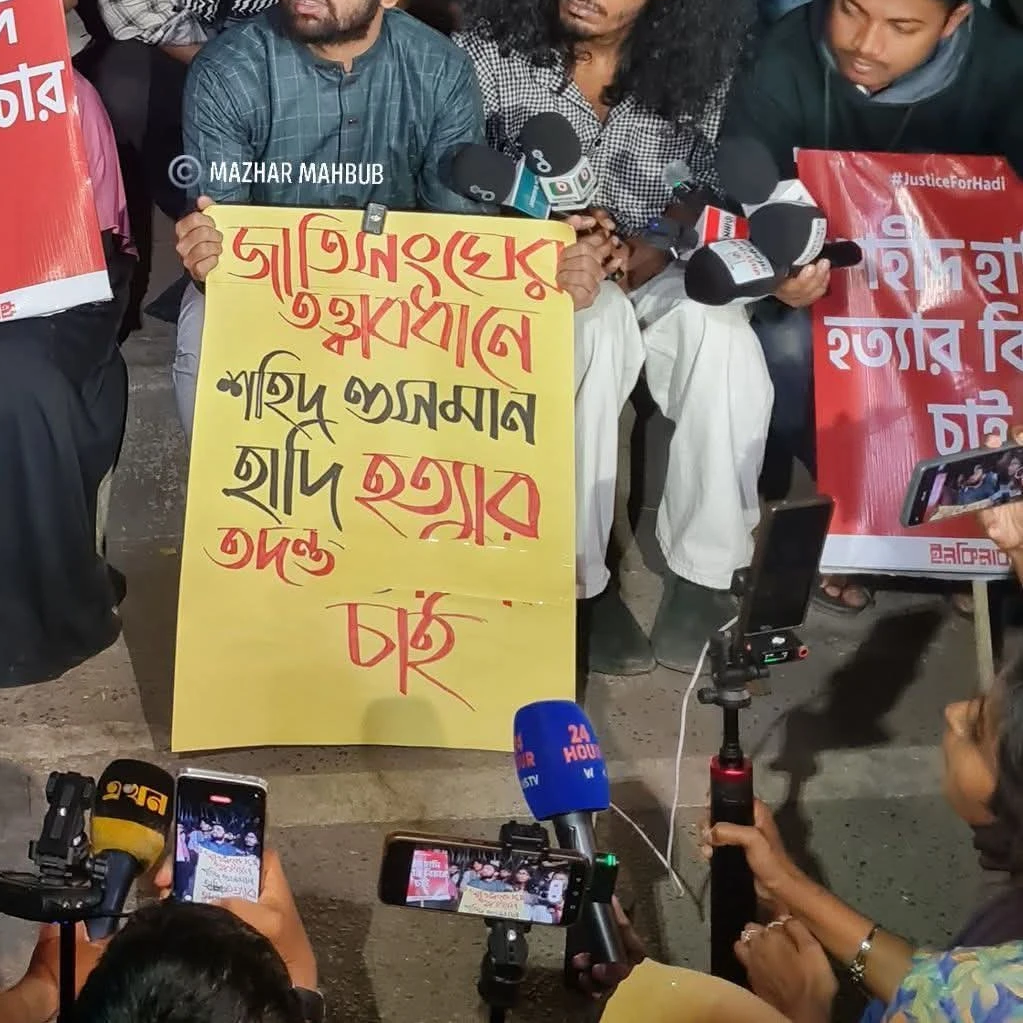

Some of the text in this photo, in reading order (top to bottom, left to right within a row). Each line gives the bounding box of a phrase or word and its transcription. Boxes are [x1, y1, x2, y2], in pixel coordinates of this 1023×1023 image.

[890, 172, 1006, 191] #JusticeForHadi
[824, 311, 965, 375] হত্যার
[222, 419, 541, 546] হাদি হত্যার
[203, 527, 345, 587] তদন্ত
[325, 589, 488, 711] চাই
[568, 724, 590, 744] 24
[102, 781, 168, 816] এখন
